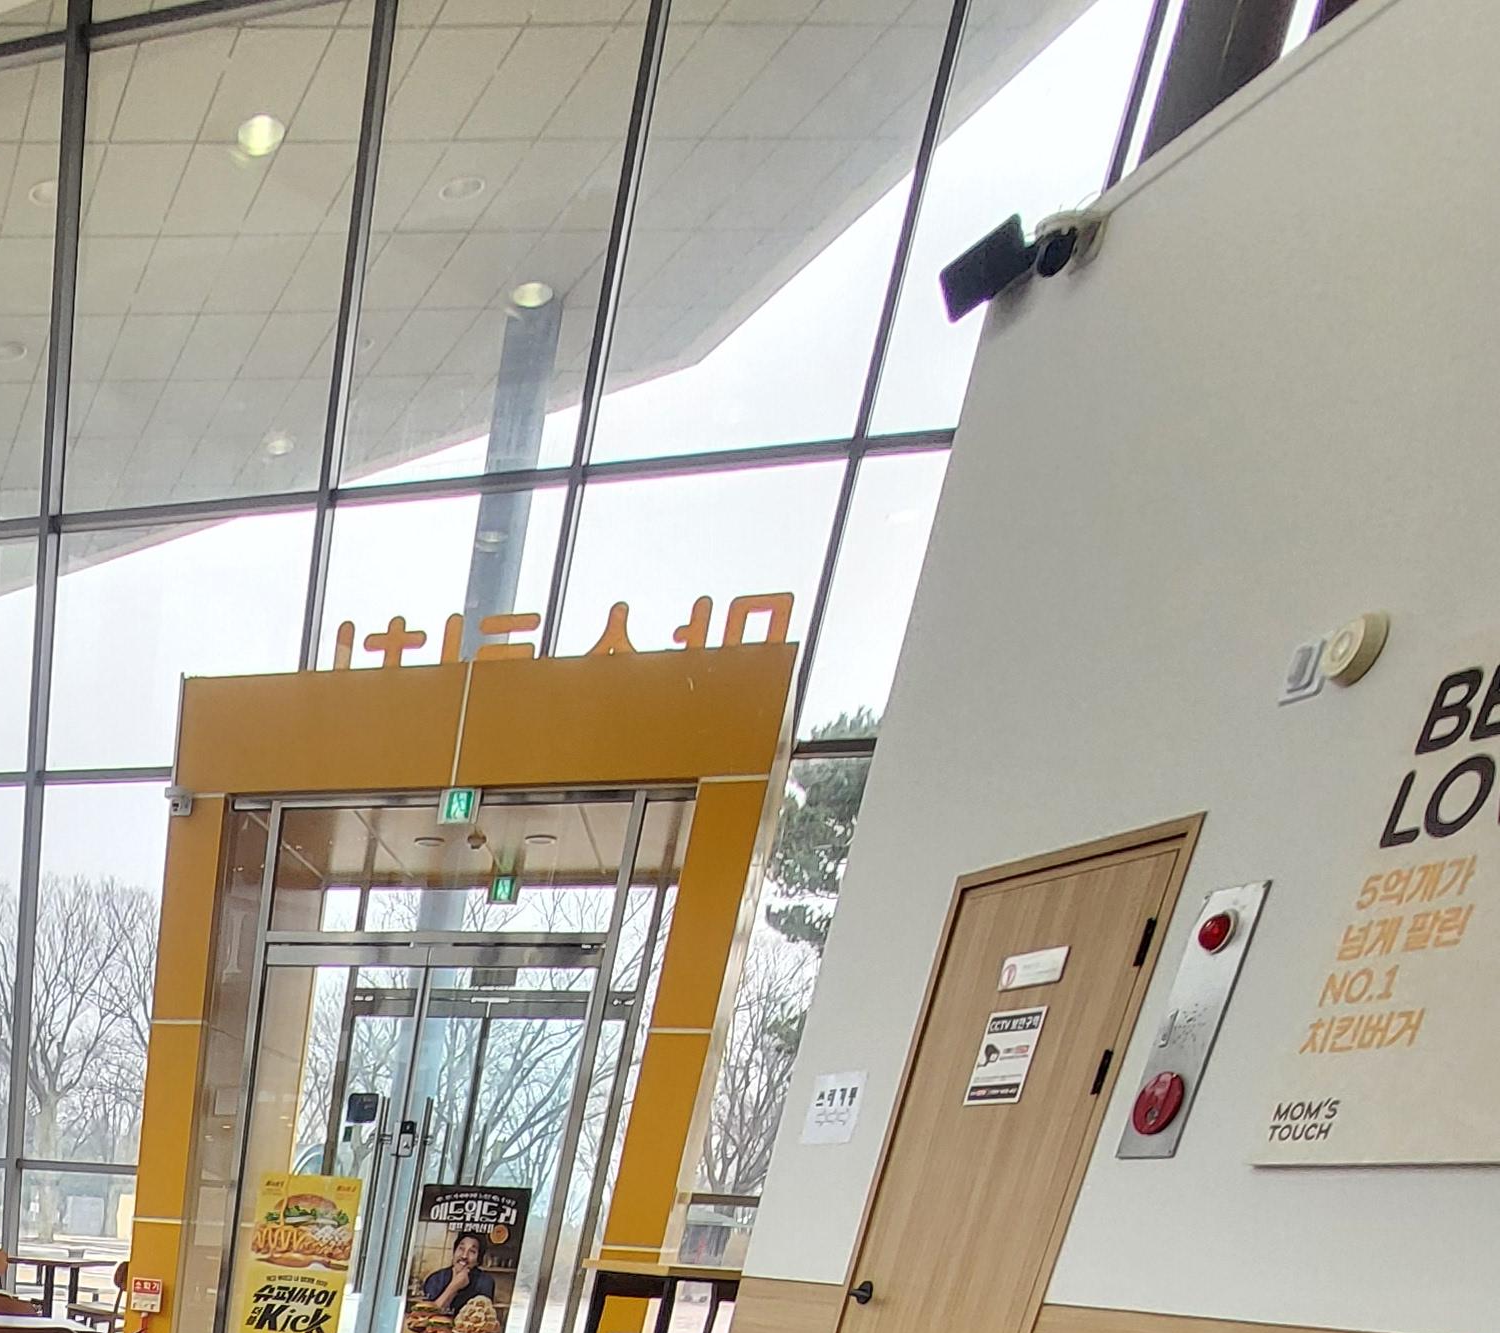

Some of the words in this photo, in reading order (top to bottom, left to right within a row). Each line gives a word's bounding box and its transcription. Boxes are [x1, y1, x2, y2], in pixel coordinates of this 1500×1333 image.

[1379, 753, 1500, 849] LO
[1357, 854, 1477, 910] 5억개가
[1337, 915, 1404, 961] 넘게
[1402, 903, 1475, 952] 팔린
[1318, 964, 1399, 1008] NO.1
[1299, 1007, 1426, 1055] 치킨버거
[1268, 1122, 1334, 1142] TOUCH
[1272, 1096, 1341, 1121] MOM'S
